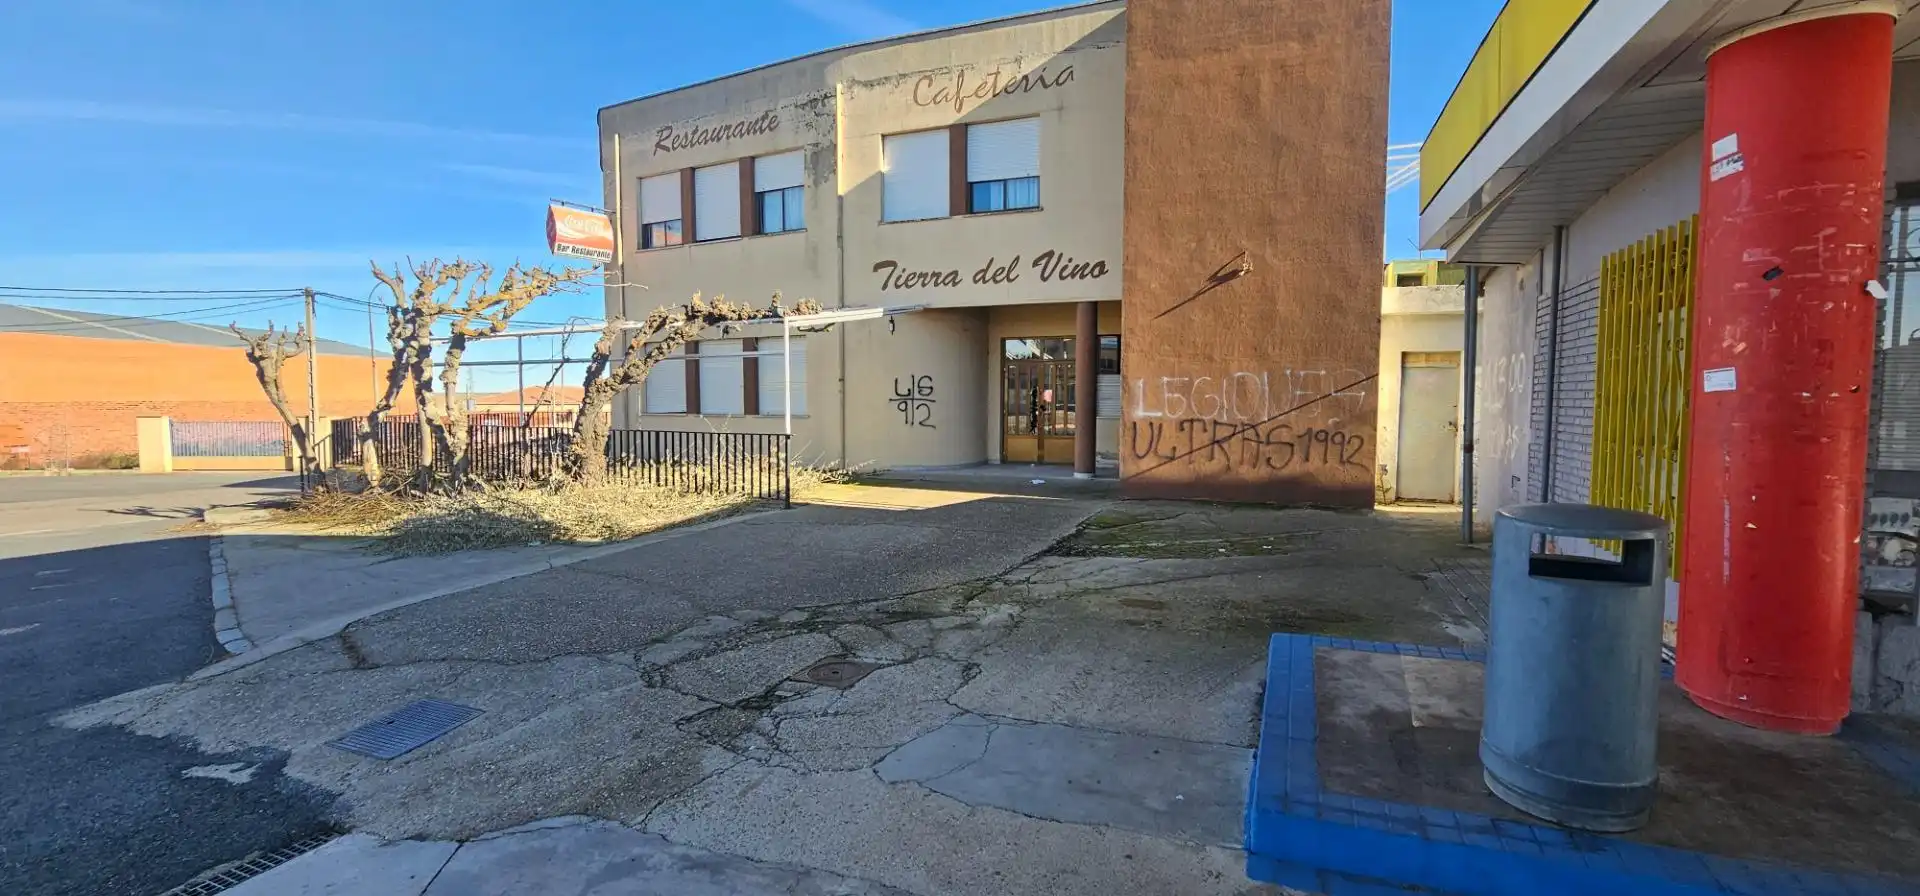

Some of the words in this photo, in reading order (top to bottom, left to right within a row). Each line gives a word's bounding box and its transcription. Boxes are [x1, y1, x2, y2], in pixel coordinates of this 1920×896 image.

[653, 109, 781, 156] Restaurante
[556, 243, 570, 252] Bar
[571, 245, 611, 259] Restaurante
[872, 259, 962, 291] Tierra
[972, 254, 1021, 285] del
[1032, 248, 1109, 283] Vino
[1130, 418, 1294, 471] ULTRAS
